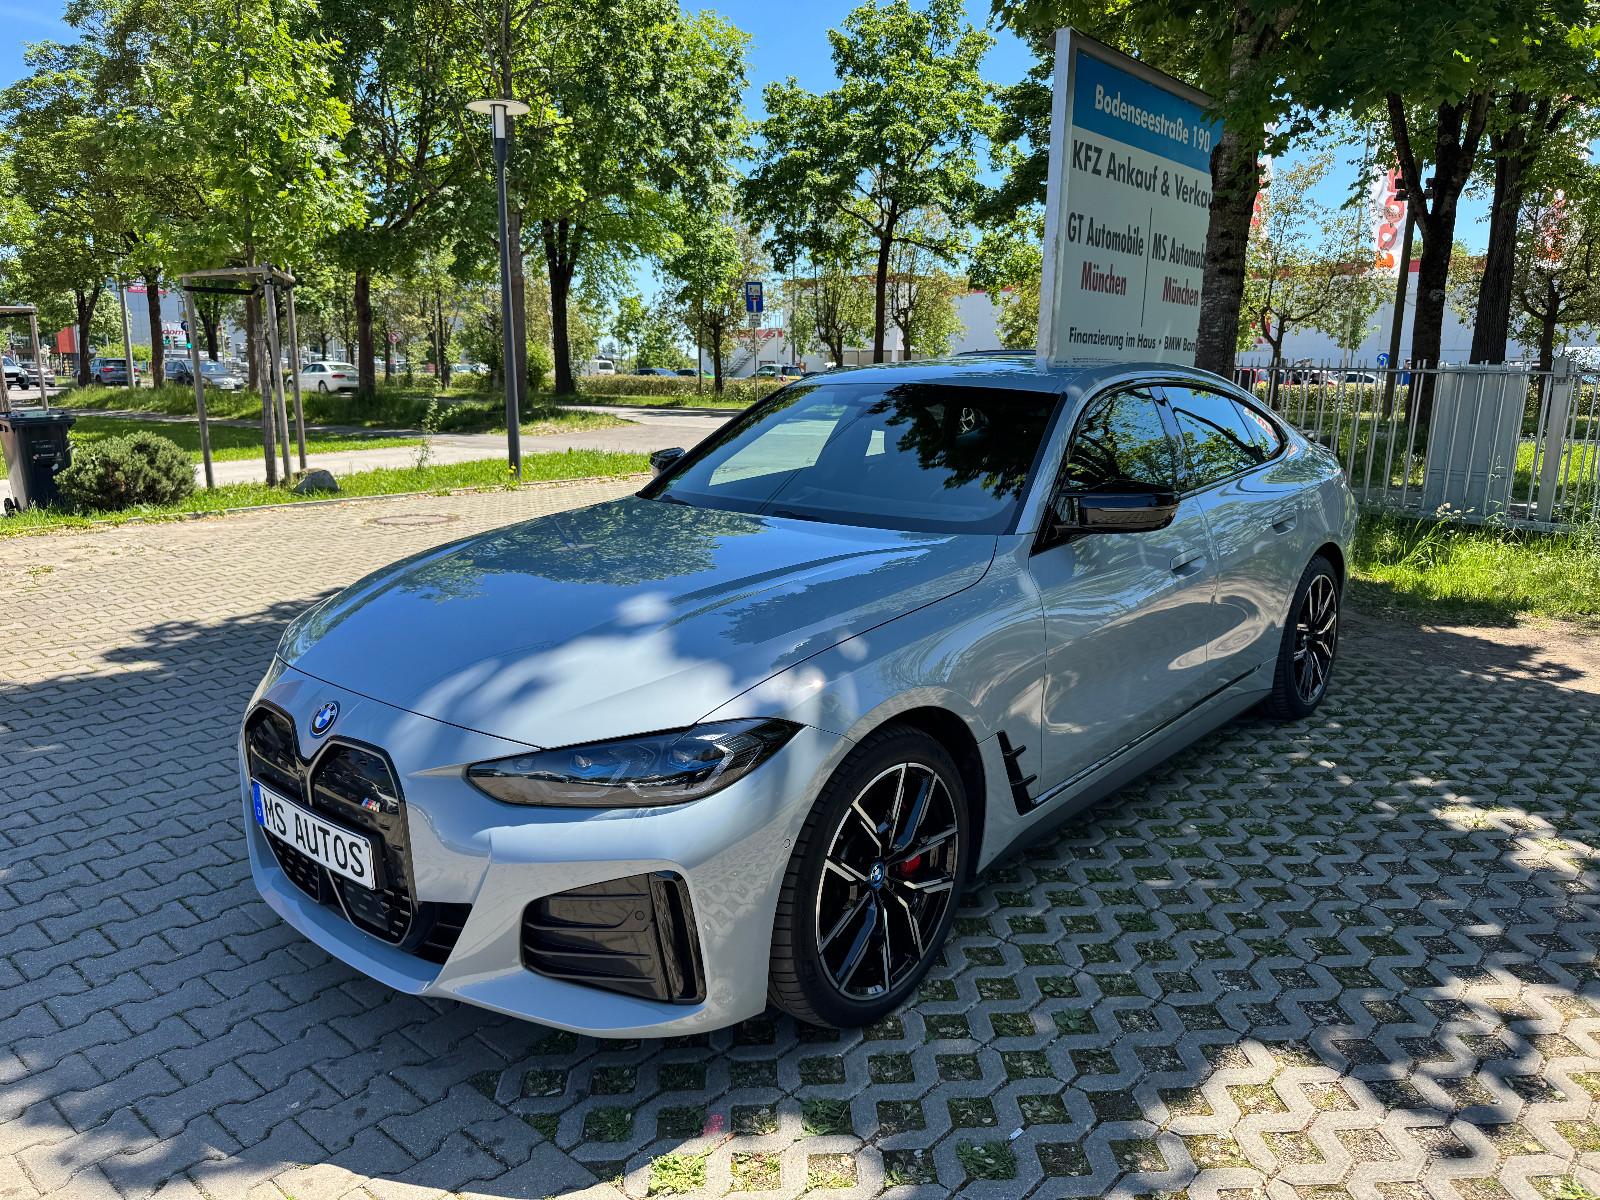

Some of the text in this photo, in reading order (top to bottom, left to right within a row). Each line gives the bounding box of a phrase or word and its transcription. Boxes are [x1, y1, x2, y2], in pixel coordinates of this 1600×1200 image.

[1094, 84, 1211, 153] Bodenseestraße 190
[1072, 139, 1103, 176] KFZ
[1106, 152, 1158, 193] Ankauf
[1160, 170, 1170, 197] &
[1175, 173, 1213, 210] Verkau
[1067, 212, 1144, 257] GT Automobile
[1152, 233, 1207, 270] MS Automob
[1080, 261, 1127, 296] München
[1162, 276, 1199, 307] München
[1068, 326, 1197, 352] Finanzierung im Haus BMW Ban
[263, 793, 365, 878] MS AUTOS
